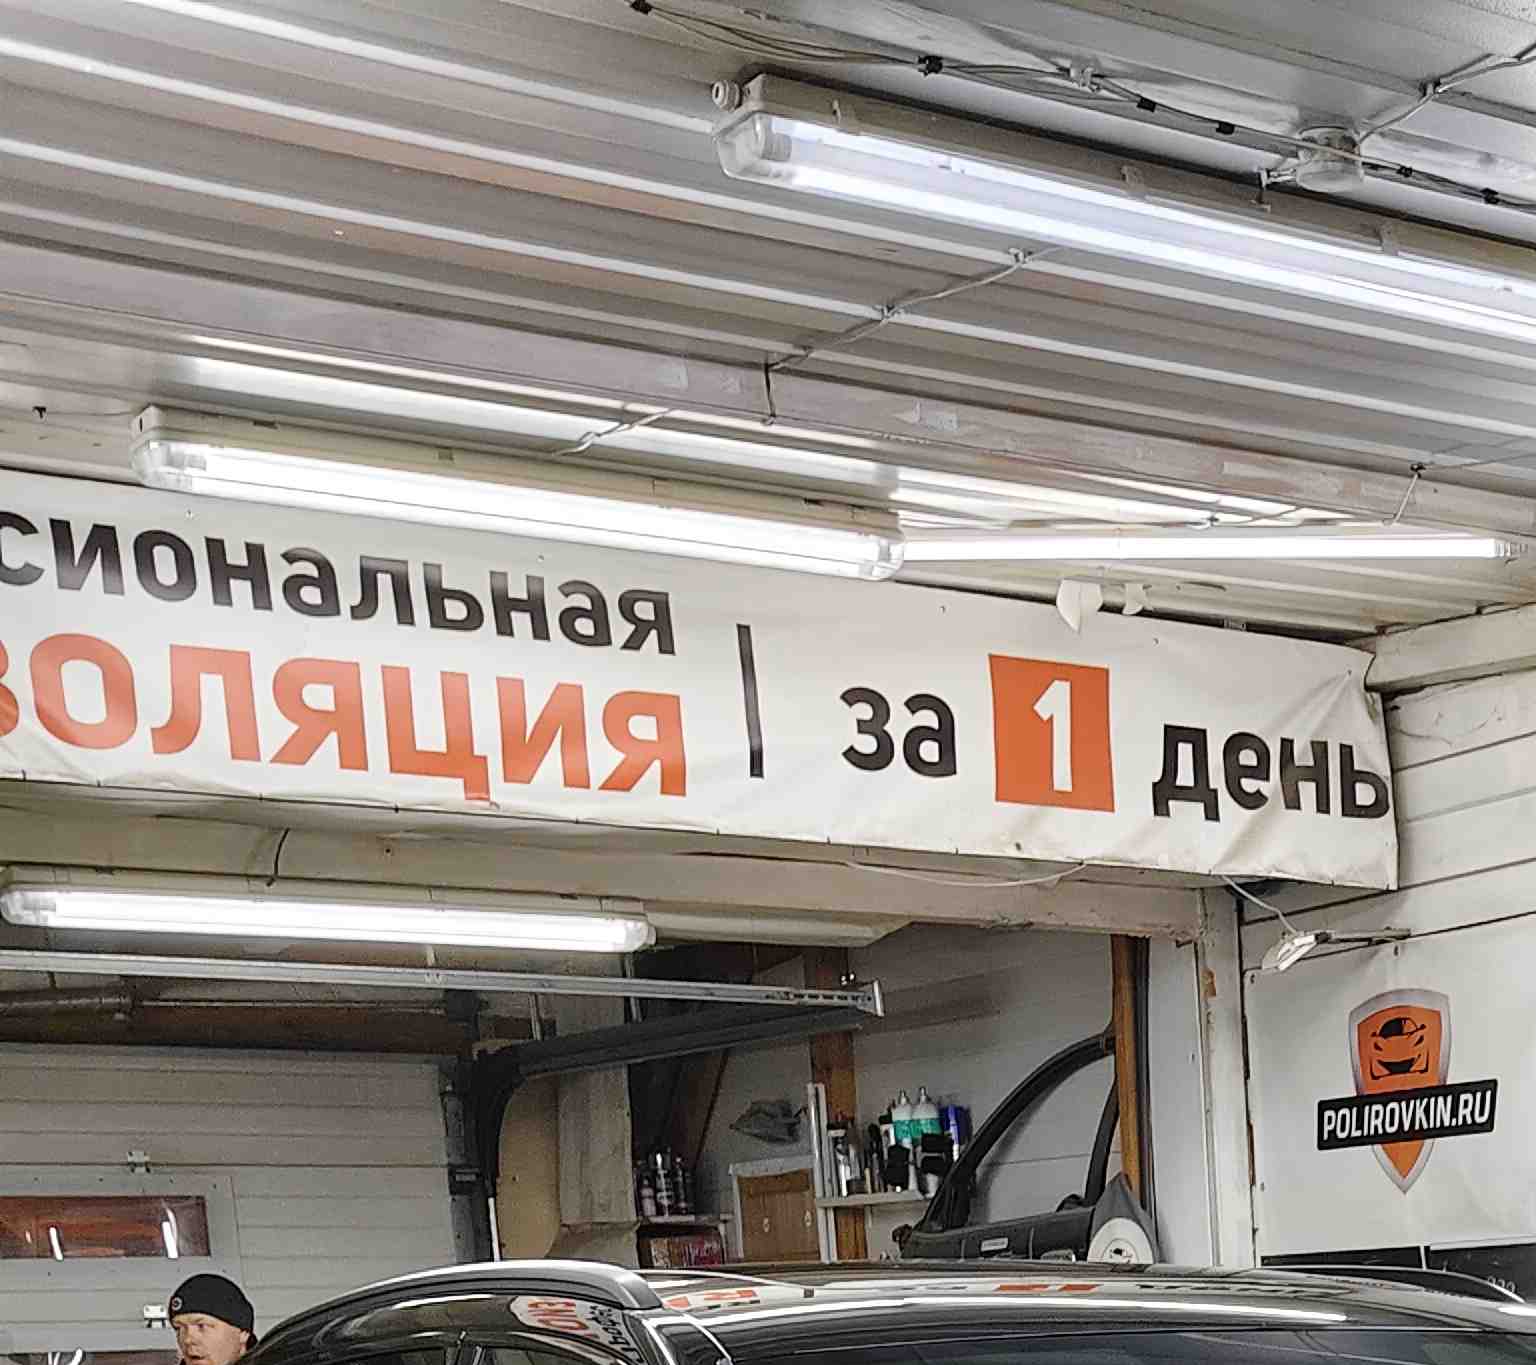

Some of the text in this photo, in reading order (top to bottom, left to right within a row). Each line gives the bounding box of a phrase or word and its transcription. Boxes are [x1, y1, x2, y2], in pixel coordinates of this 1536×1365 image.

[0, 633, 687, 801] ОЛЯЦИЯ
[839, 680, 1391, 823] за 1 день
[1321, 1088, 1494, 1141] POLIROVKIN.RU
